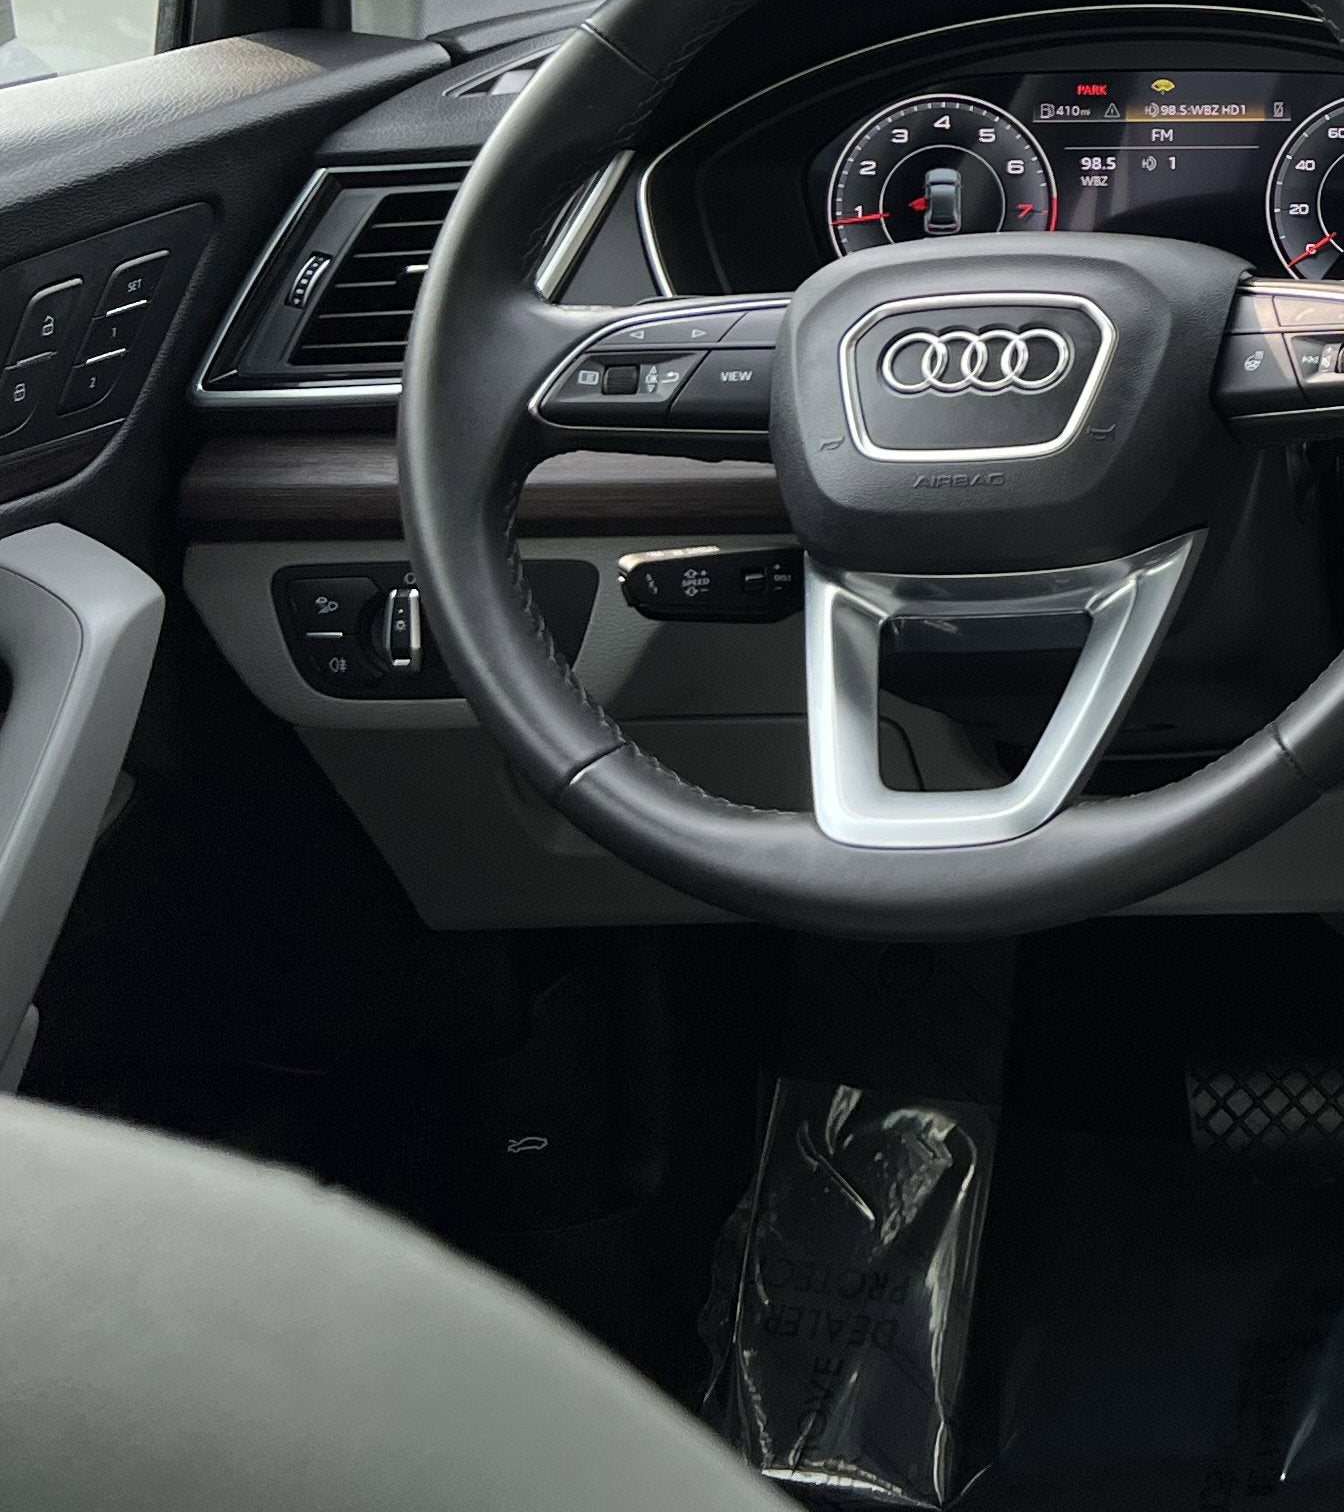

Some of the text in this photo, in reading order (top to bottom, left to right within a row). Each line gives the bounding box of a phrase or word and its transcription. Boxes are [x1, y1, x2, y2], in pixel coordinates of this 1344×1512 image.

[1077, 84, 1108, 95] PARK
[1056, 105, 1080, 116] 410
[1221, 105, 1246, 115] HD1
[934, 115, 950, 129] 4
[891, 129, 909, 143] 3
[979, 128, 996, 142] 5
[1151, 129, 1174, 141] FM
[859, 161, 876, 175] 2
[1007, 160, 1025, 173] 6
[1080, 157, 1117, 170] 98.5
[1295, 160, 1316, 170] 40
[1080, 176, 1108, 186] WBZ
[854, 205, 863, 218] 1
[1017, 203, 1034, 218] 7
[1289, 204, 1309, 215] 20
[128, 279, 142, 292] SET
[112, 328, 117, 337] 1
[90, 377, 96, 388] 2
[720, 371, 753, 382] VIEW
[913, 473, 1005, 488] AIRBAG
[682, 577, 710, 586] SPEED
